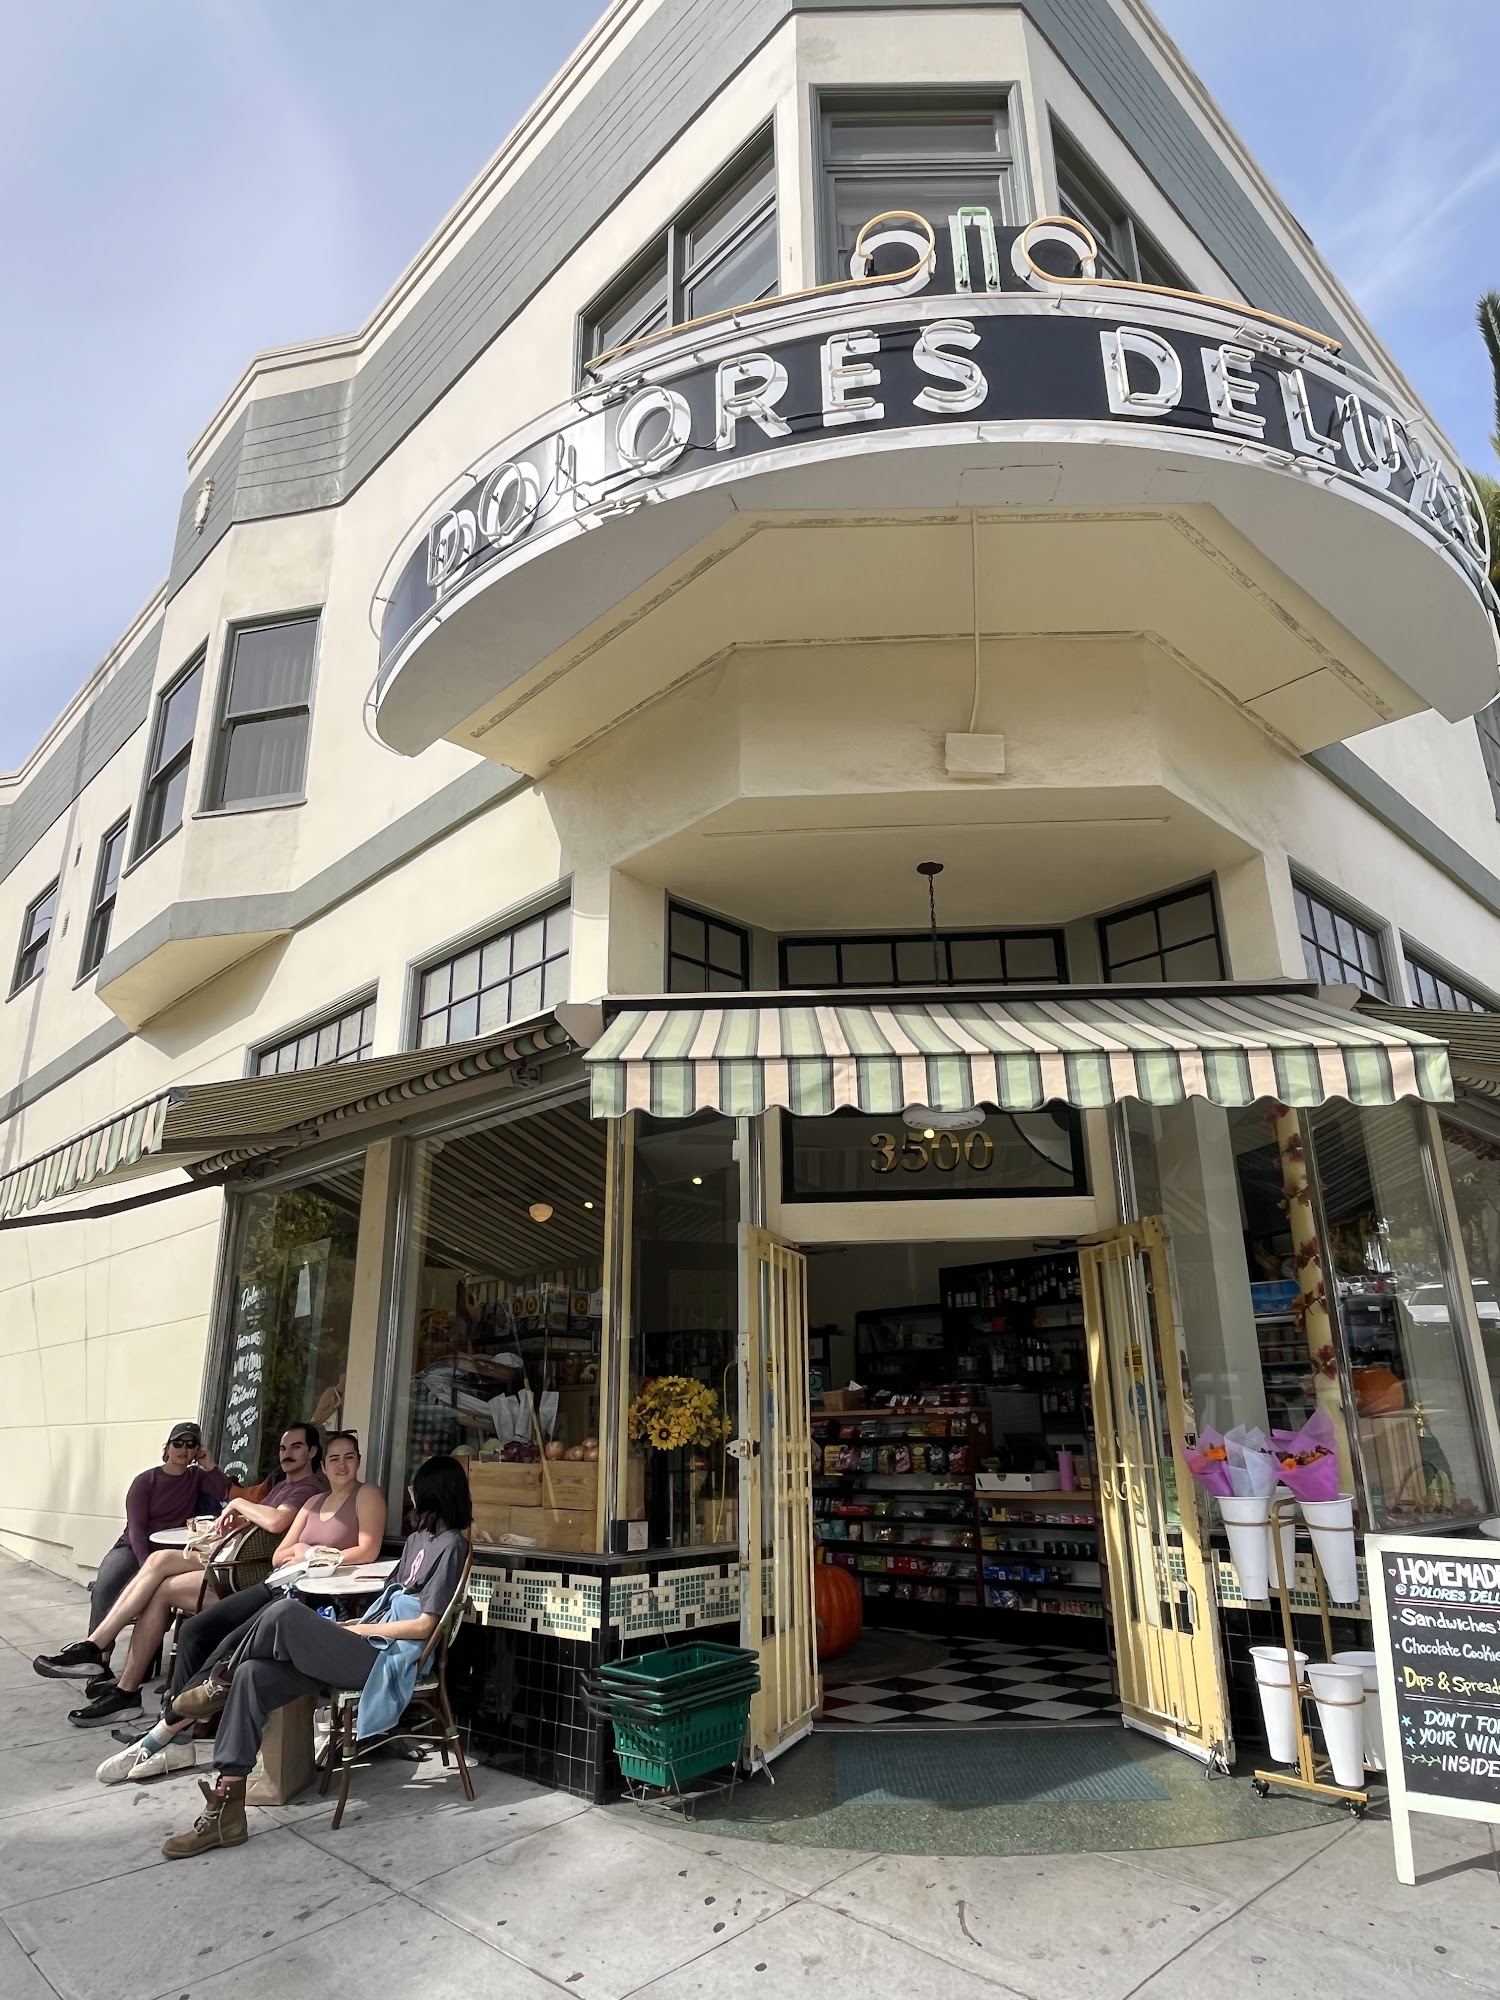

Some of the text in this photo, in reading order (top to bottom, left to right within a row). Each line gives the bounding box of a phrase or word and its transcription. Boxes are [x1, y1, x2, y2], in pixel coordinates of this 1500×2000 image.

[427, 319, 989, 602] DOLORES
[870, 1130, 994, 1174] 3500
[1395, 1583, 1407, 1595] @
[1409, 1584, 1467, 1602] DOLORES
[1400, 1608, 1497, 1635] Sandwiches
[1401, 1637, 1461, 1658] Chocolate
[1403, 1666, 1434, 1693] Dips
[1438, 1671, 1451, 1693] &
[1423, 1710, 1473, 1729] DON'T
[1419, 1728, 1458, 1749] YOUR
[1442, 1754, 1500, 1778] INSIDE
